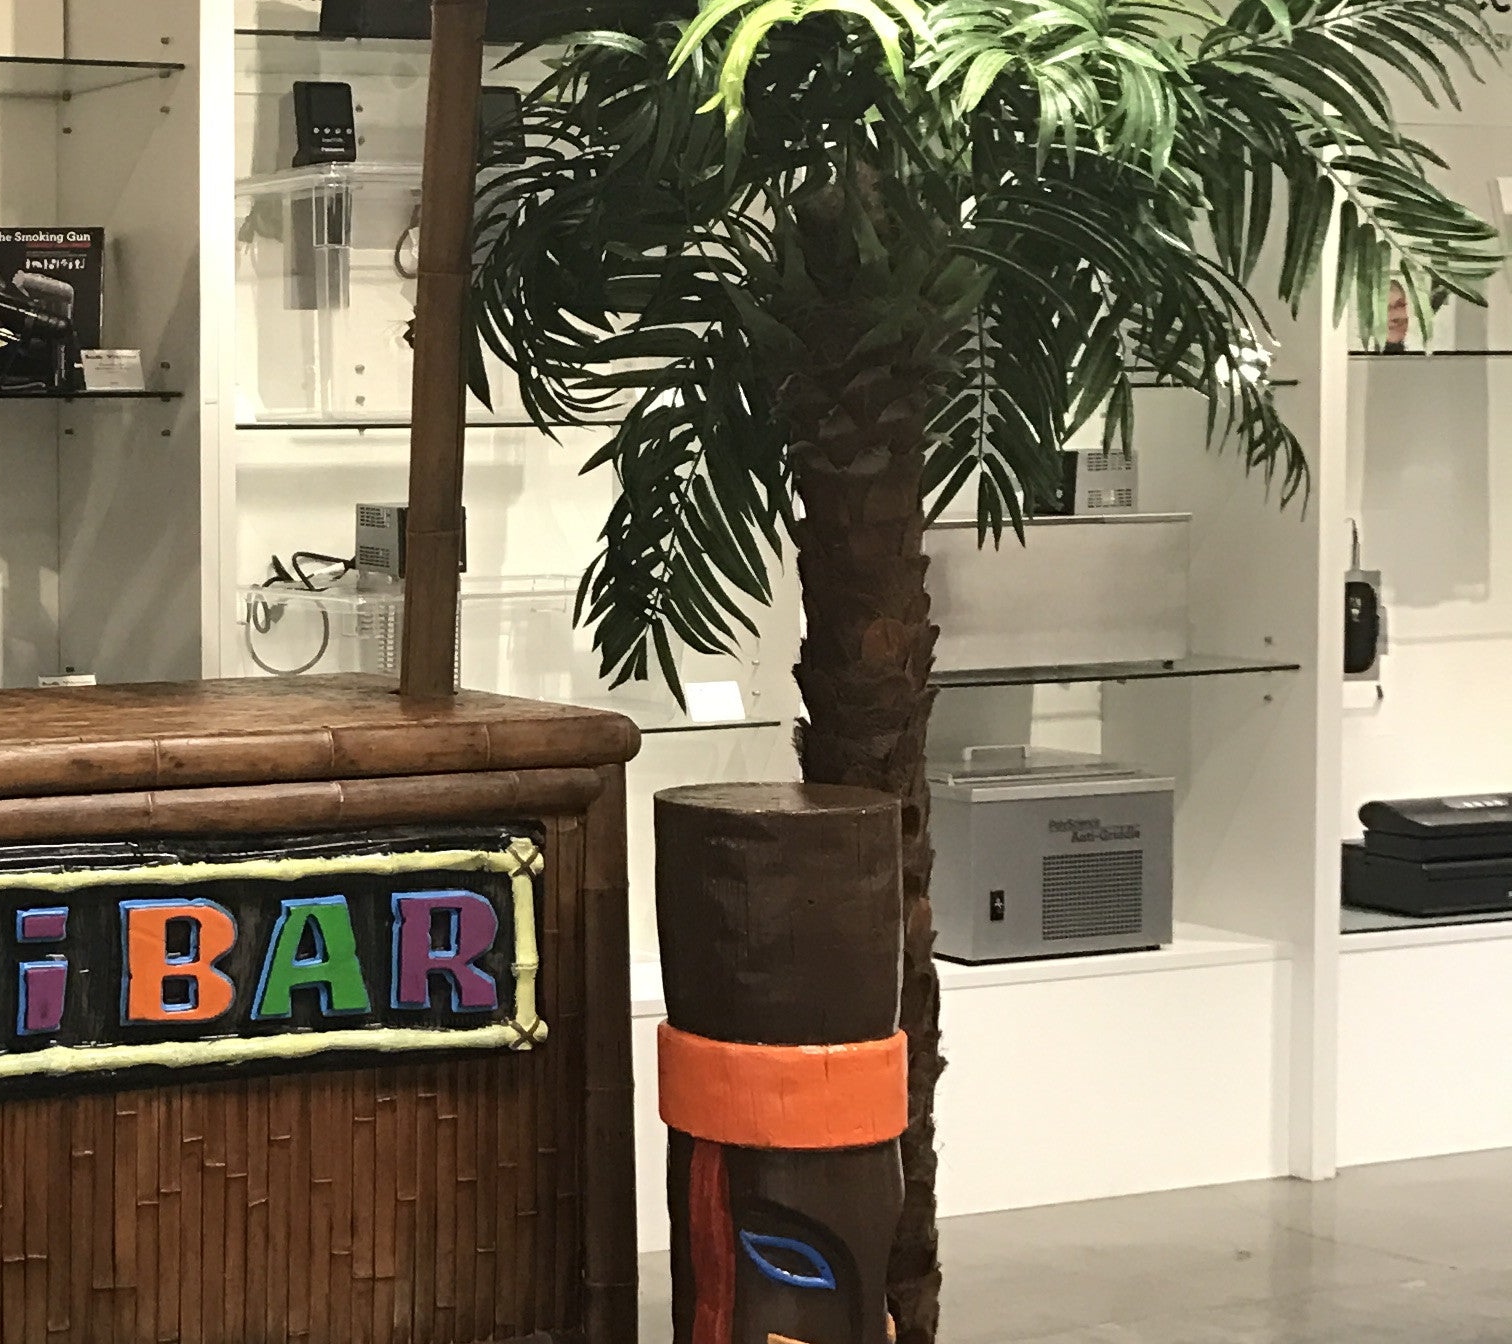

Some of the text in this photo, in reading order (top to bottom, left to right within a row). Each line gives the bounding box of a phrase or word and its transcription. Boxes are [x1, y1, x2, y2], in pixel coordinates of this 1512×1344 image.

[14, 231, 64, 244] Smoking
[66, 231, 91, 242] Gun
[119, 889, 501, 1027] BAR
